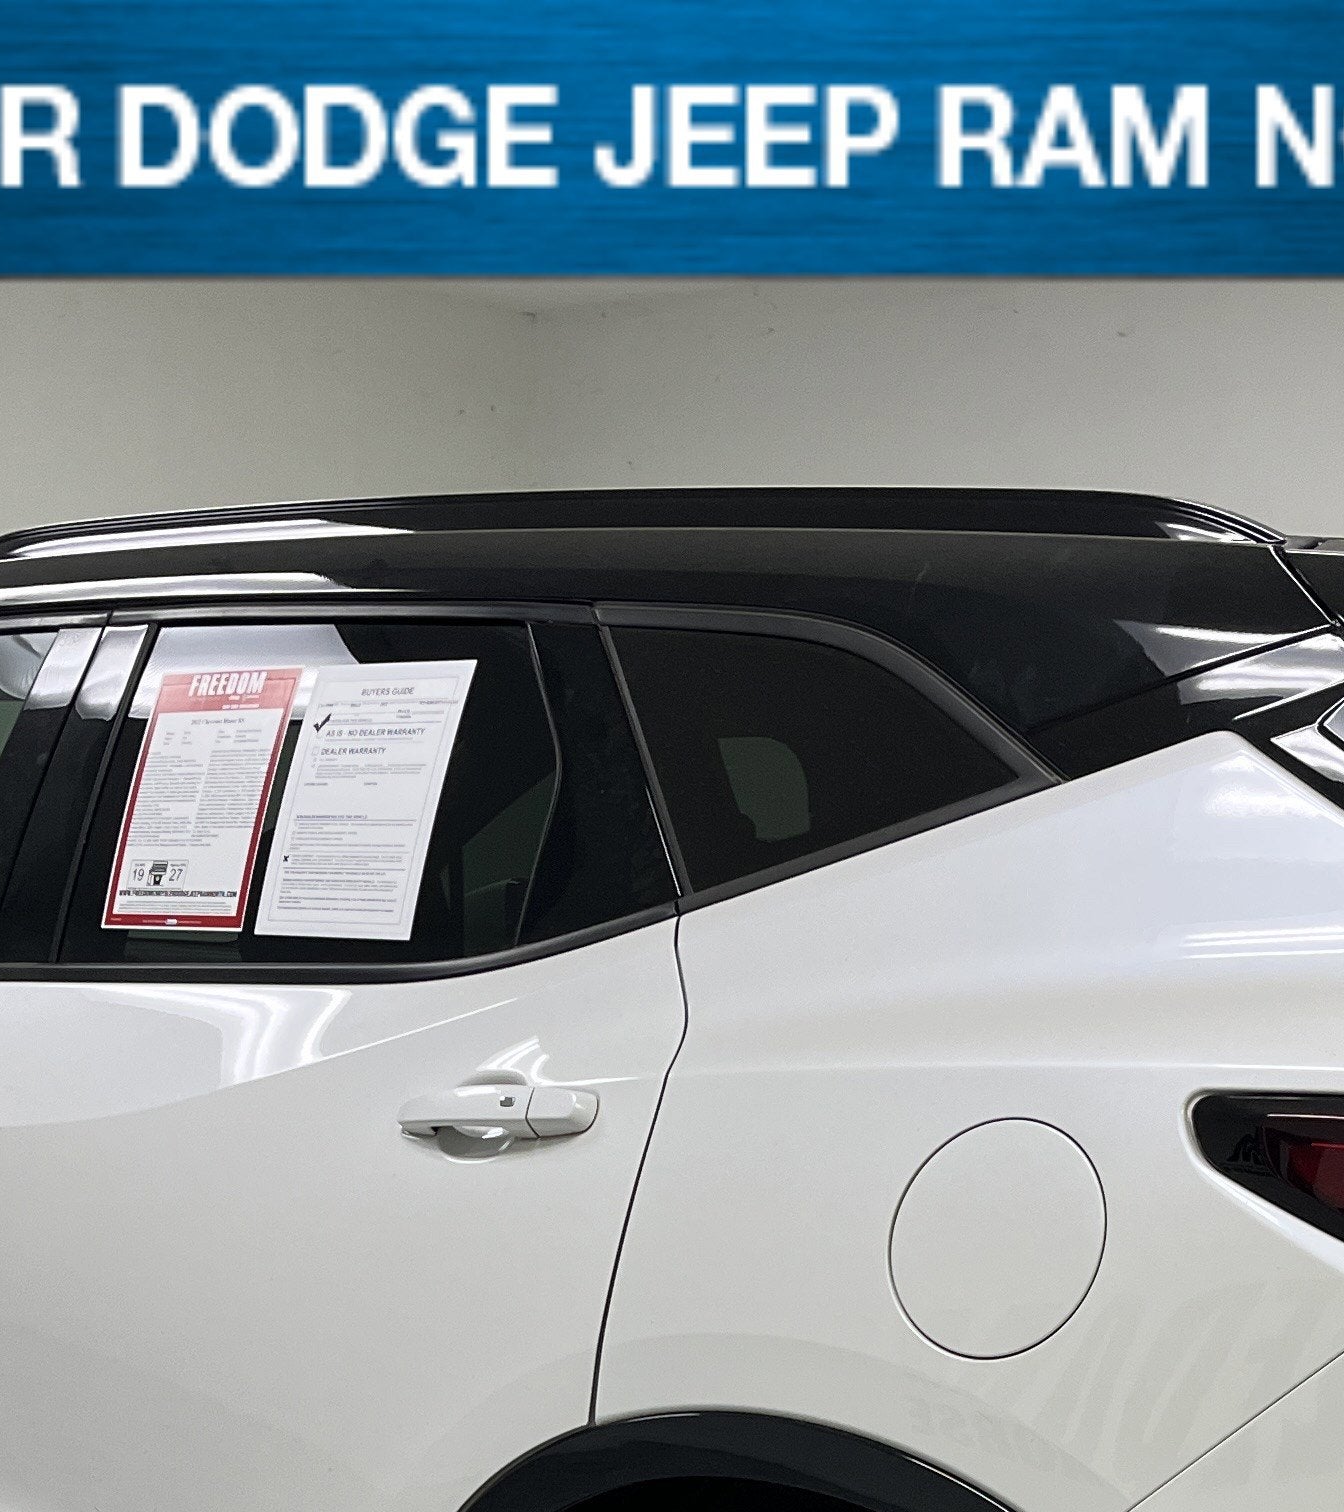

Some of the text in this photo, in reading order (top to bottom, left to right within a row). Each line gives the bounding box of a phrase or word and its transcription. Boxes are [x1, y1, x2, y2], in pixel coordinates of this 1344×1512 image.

[188, 671, 268, 697] FREEDOM
[360, 686, 415, 697] BUYERS GUIDE
[325, 729, 335, 738] AS
[336, 729, 343, 738] IS
[358, 728, 386, 737] DEALER
[386, 728, 426, 737] WARRANTY
[320, 747, 386, 756] DEALER WARRANTY
[132, 868, 145, 882] 19
[168, 868, 184, 882] 27
